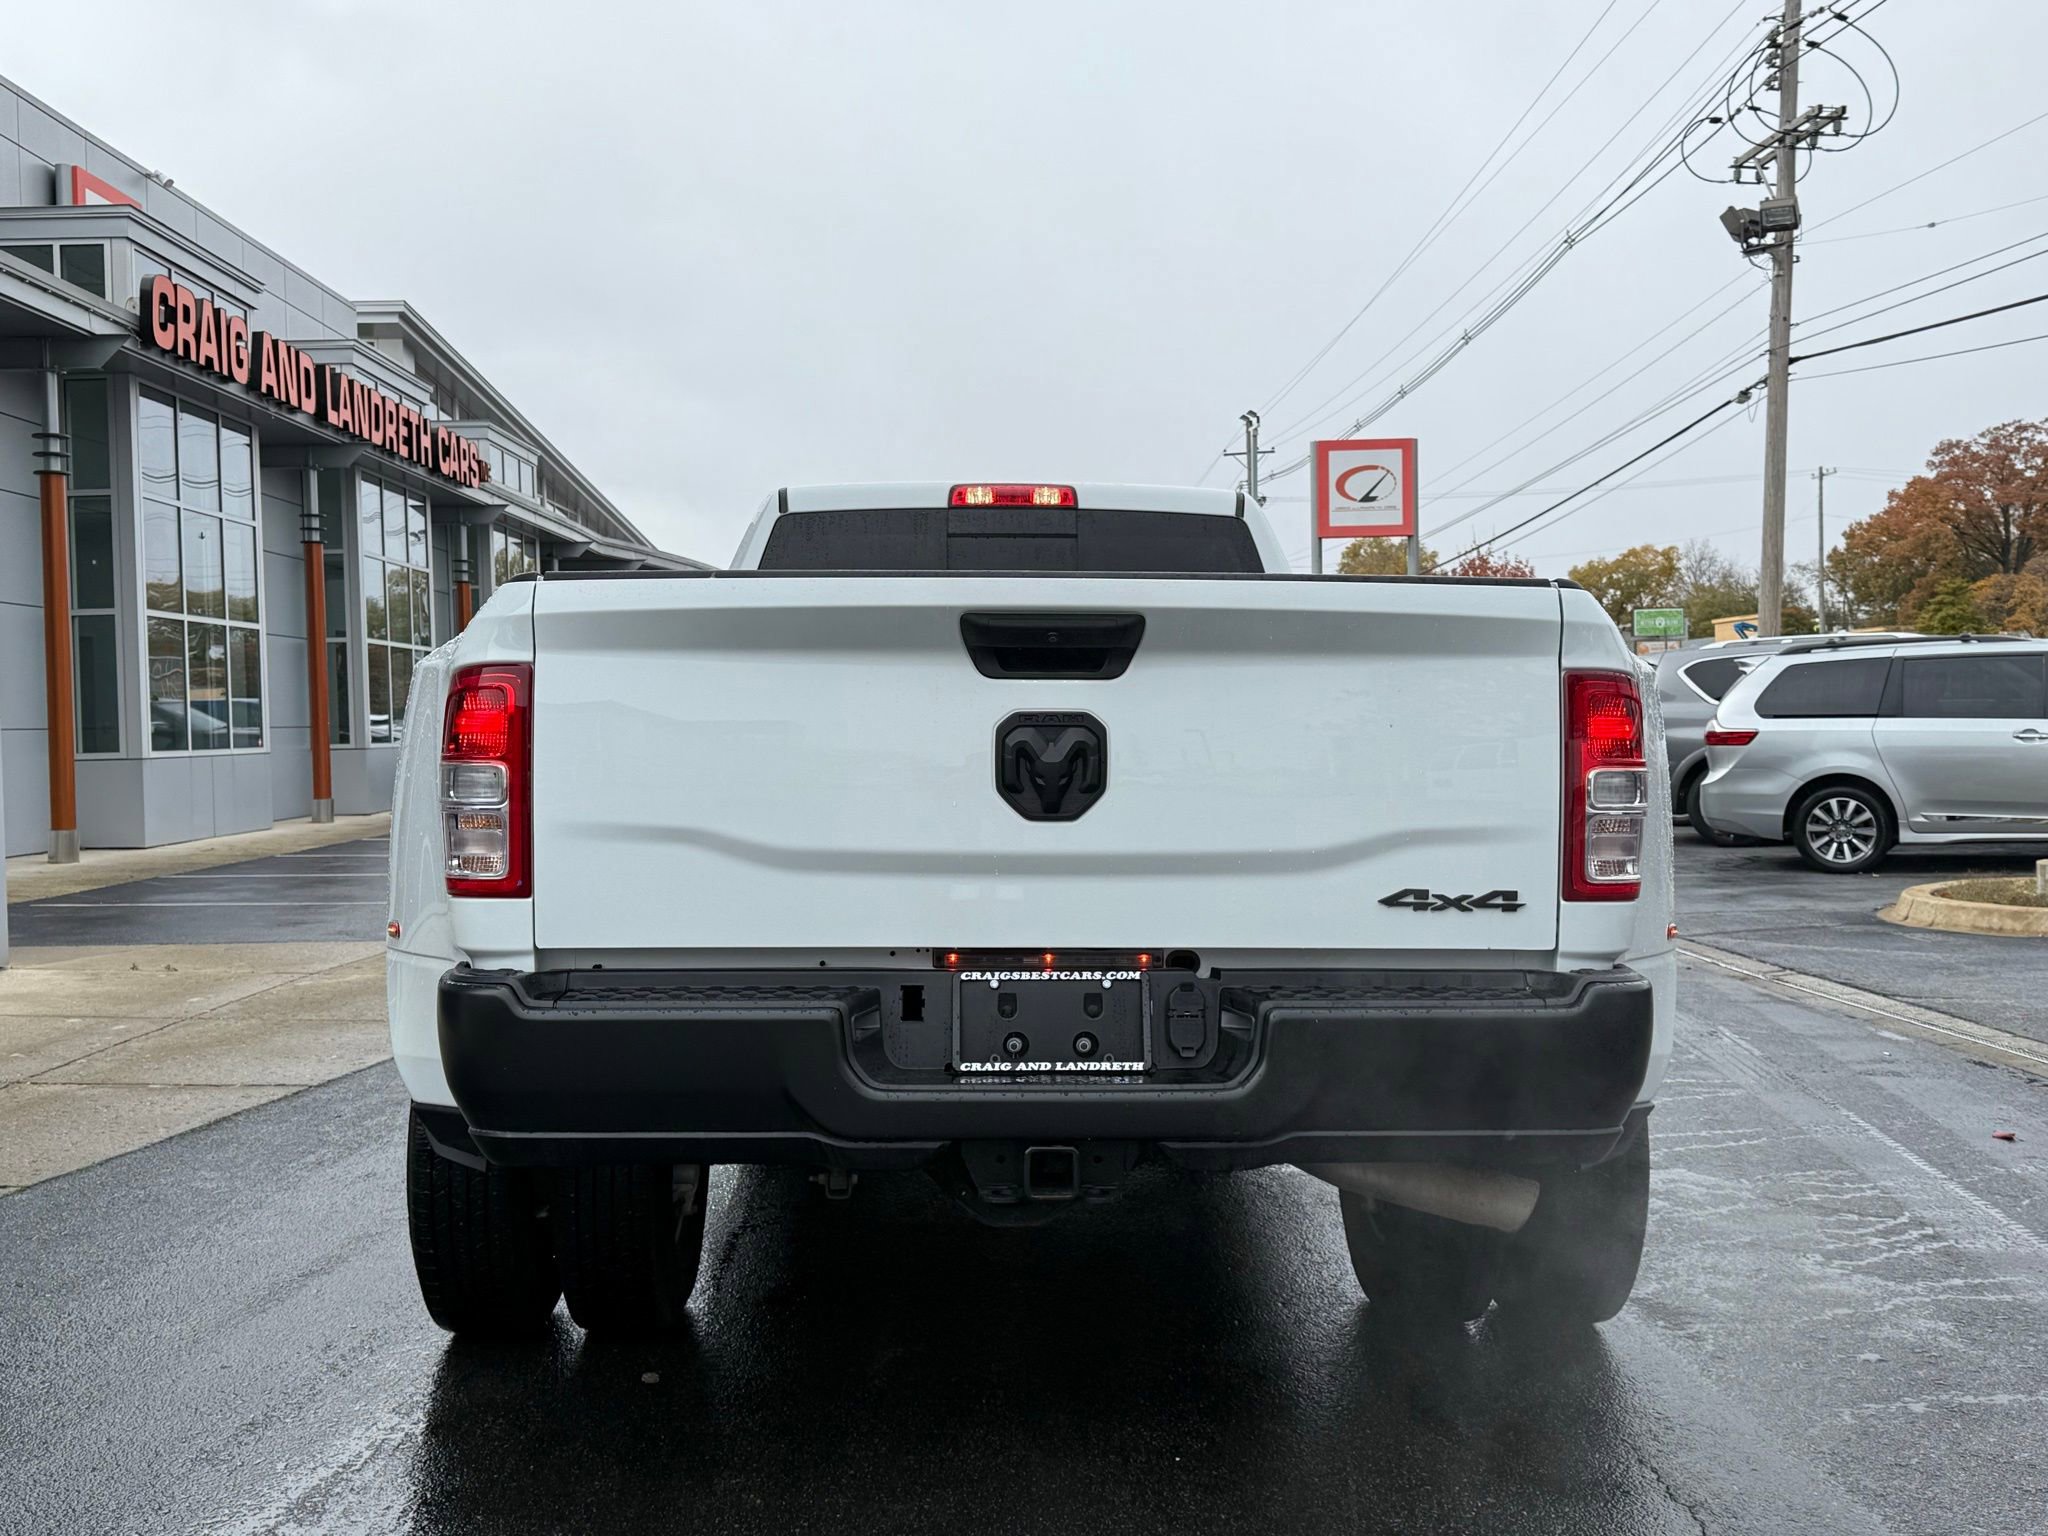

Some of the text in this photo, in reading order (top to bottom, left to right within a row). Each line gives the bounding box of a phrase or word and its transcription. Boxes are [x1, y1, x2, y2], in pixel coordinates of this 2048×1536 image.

[151, 274, 250, 384] CRAIG
[259, 331, 317, 415] AND
[324, 364, 433, 469] LANDRETH
[437, 424, 480, 489] CARS
[1018, 713, 1085, 724] RAM
[1377, 888, 1527, 913] 4x4
[960, 971, 1142, 981] CRAIGSBESTCARS.COM
[960, 1061, 1144, 1072] CRAIG AND LANDRETH
